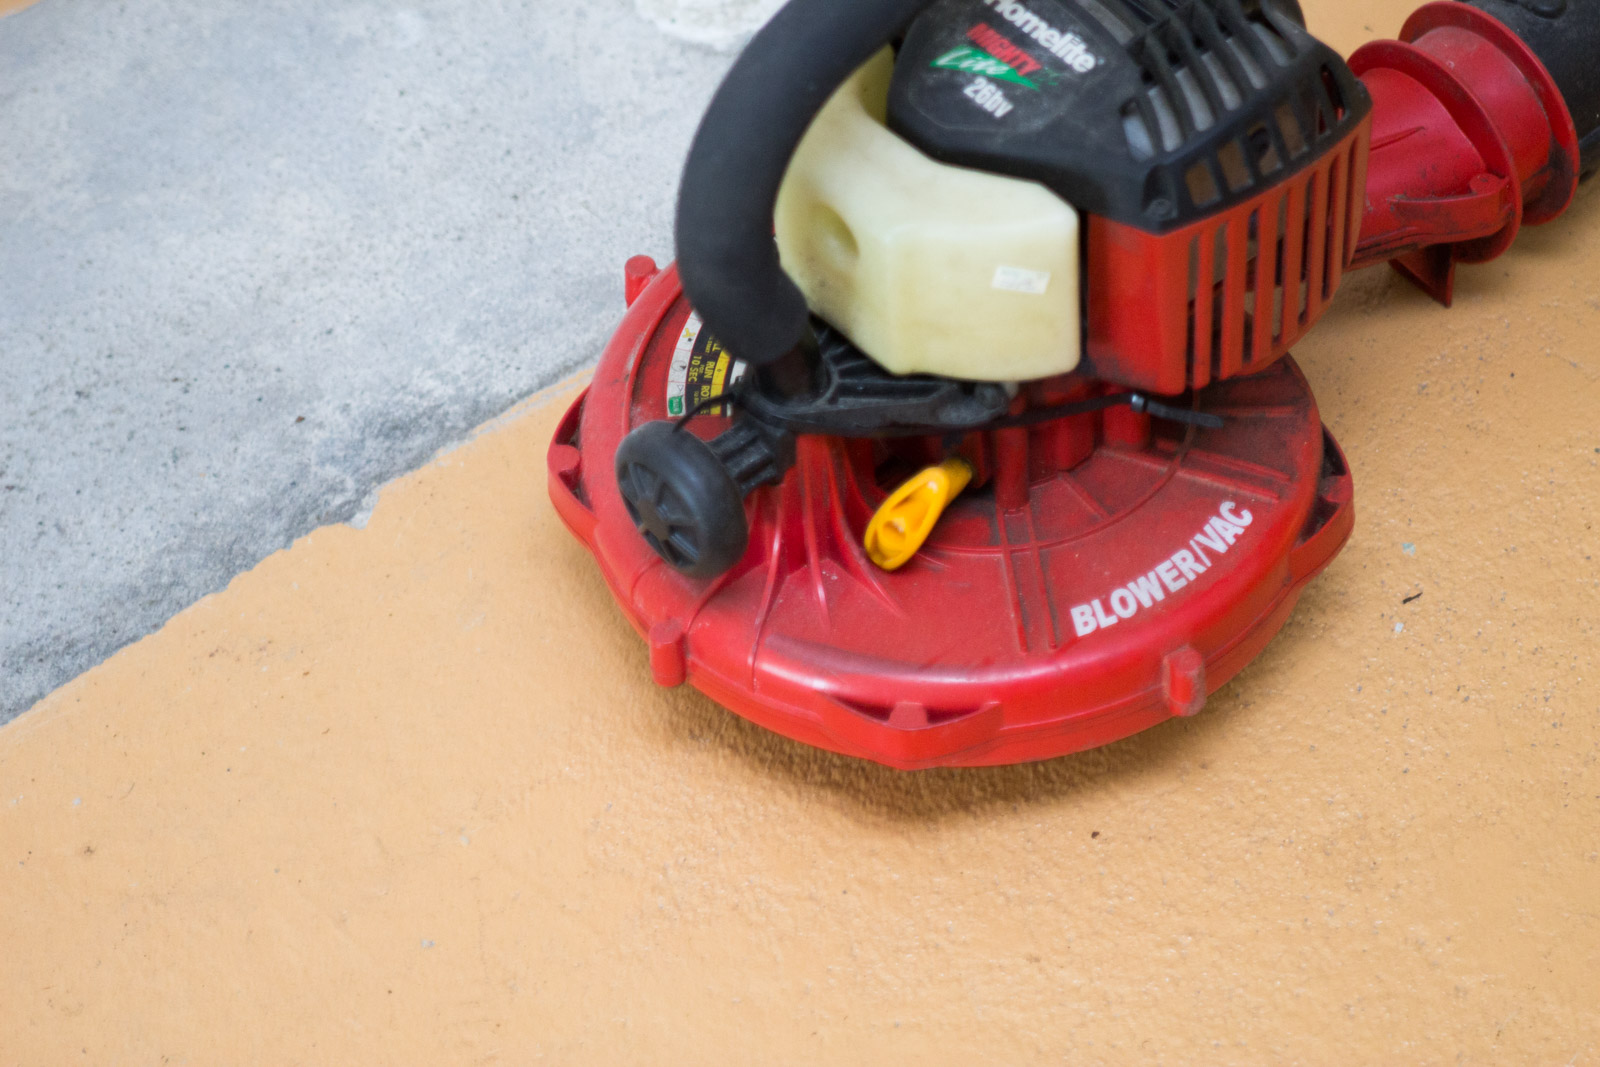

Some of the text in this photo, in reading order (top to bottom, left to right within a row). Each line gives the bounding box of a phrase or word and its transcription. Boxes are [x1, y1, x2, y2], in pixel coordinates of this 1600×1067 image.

[966, 23, 1041, 76] MIGHTY
[935, 49, 1010, 75] Lite
[691, 355, 702, 366] 10
[704, 361, 716, 379] RUN
[688, 366, 698, 382] SEC
[1070, 501, 1253, 637] BLOWER/VAC
